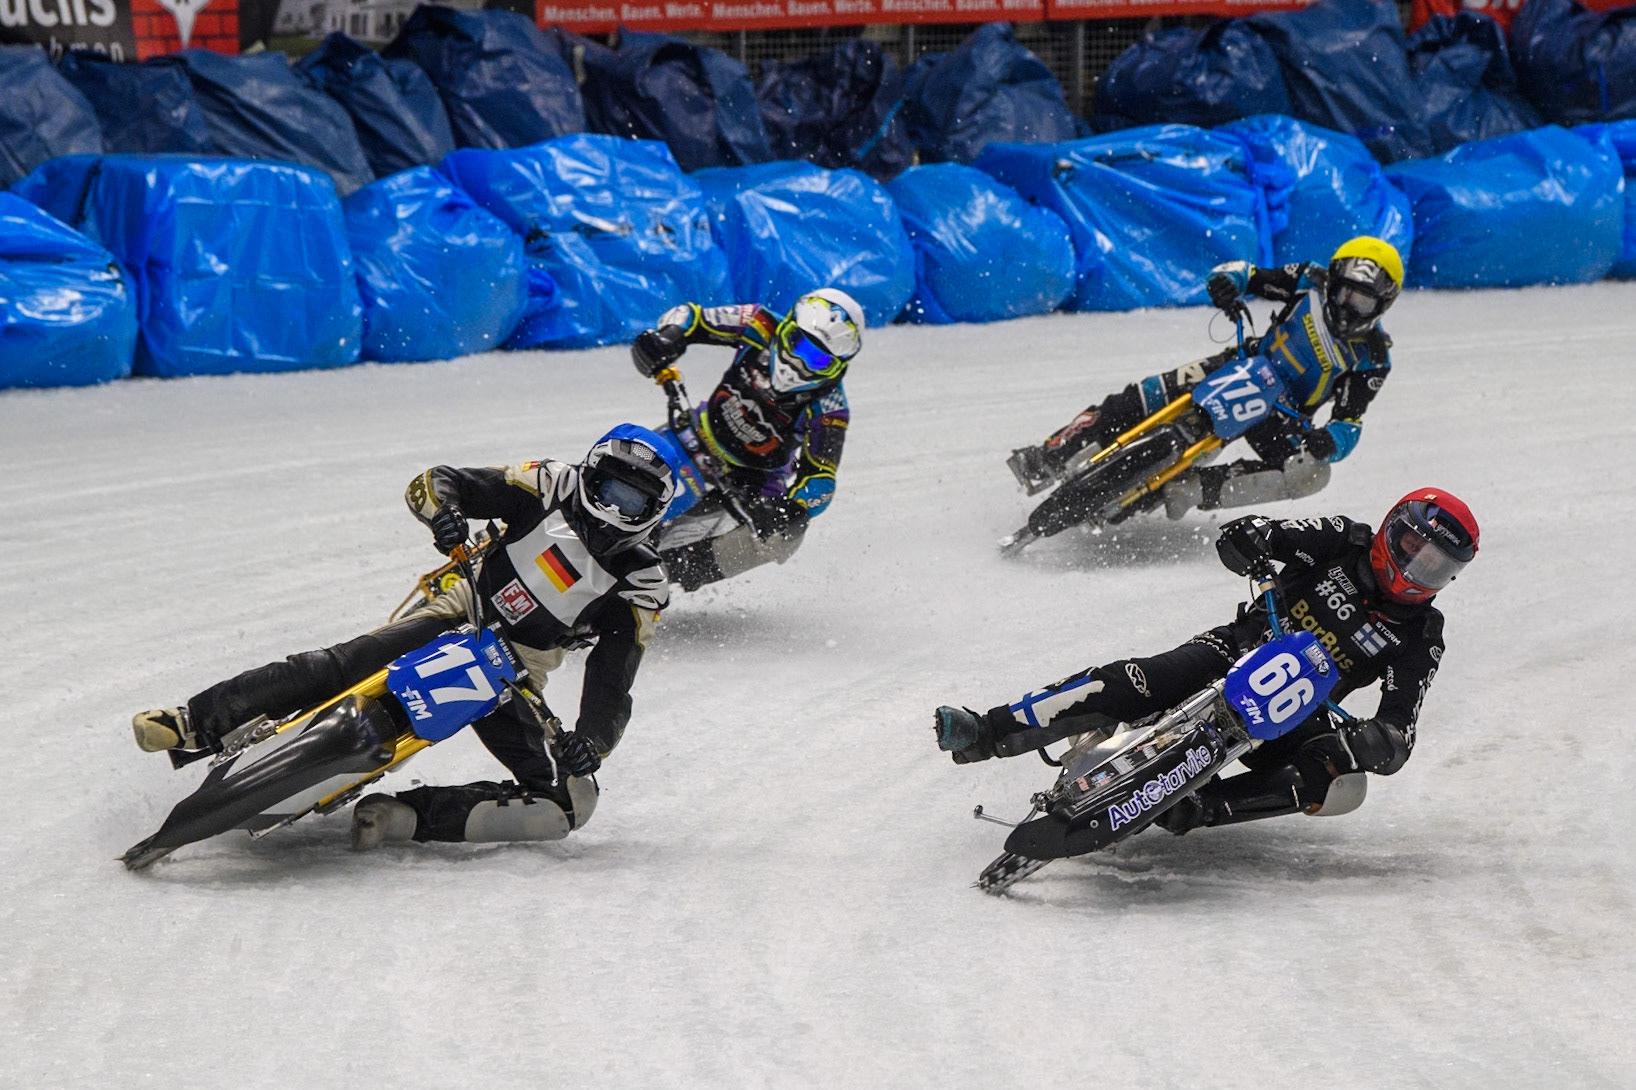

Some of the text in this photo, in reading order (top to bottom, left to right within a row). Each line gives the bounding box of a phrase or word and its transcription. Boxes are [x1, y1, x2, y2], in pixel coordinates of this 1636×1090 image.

[544, 6, 618, 22] Menschen.
[620, 4, 664, 21] Bauen.
[712, 1, 786, 19] Menschen.
[1315, 580, 1356, 620] #66
[1375, 621, 1401, 646] STORM
[414, 642, 497, 705] 17
[1248, 652, 1315, 723] 66
[401, 686, 433, 721] FIM
[1240, 694, 1265, 725] FIM
